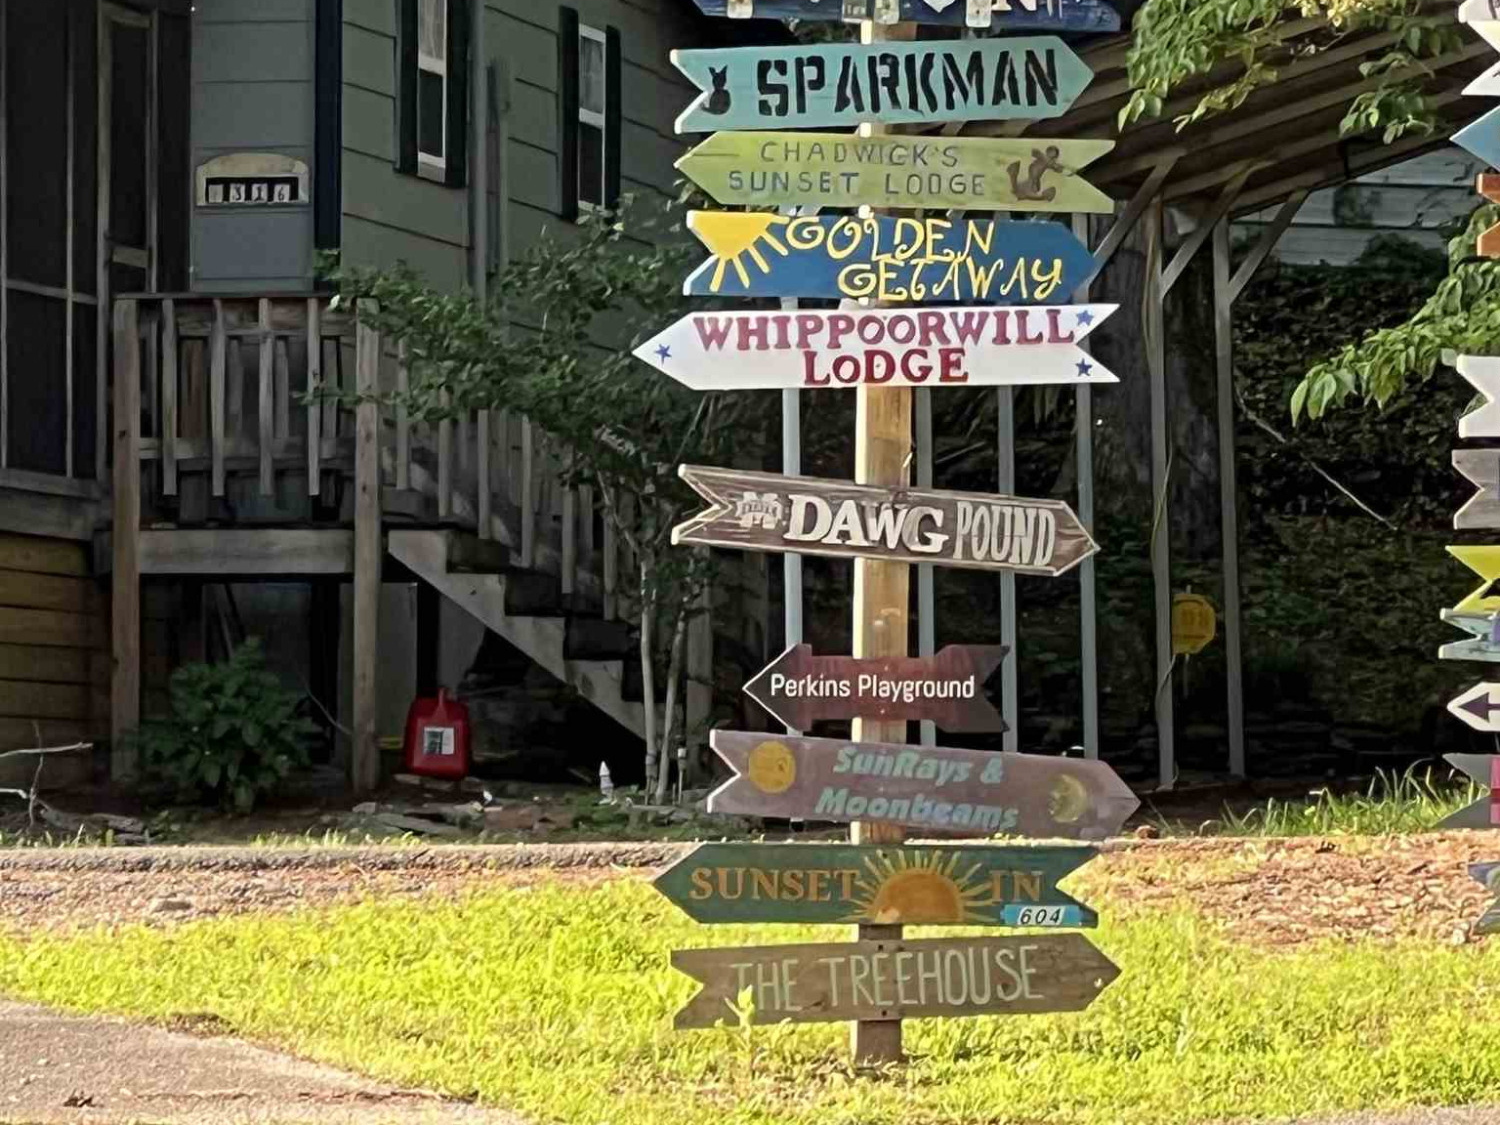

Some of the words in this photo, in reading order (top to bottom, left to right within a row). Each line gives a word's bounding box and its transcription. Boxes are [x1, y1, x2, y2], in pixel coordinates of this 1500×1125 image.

[757, 47, 1058, 116] SPARKMAN
[761, 141, 959, 167] CHADWICK'S
[729, 170, 860, 194] SUNSET
[885, 172, 985, 196] LODGE
[785, 215, 995, 264] GOLDEN
[694, 308, 1075, 351] WHIPPOORWILL
[803, 347, 968, 386] LODGE
[784, 494, 950, 554] DAWG
[953, 501, 1056, 566] POUND
[771, 673, 851, 697] Perkins
[858, 675, 974, 703] Playground
[834, 747, 973, 783] SunRays
[980, 756, 1003, 783] &
[815, 787, 1019, 830] Moonbeams
[689, 867, 861, 903] SUNSET
[990, 869, 1045, 904] IN
[1019, 907, 1062, 925] 604
[730, 960, 802, 1012] THE
[819, 945, 1045, 1007] TREEHOUSE
